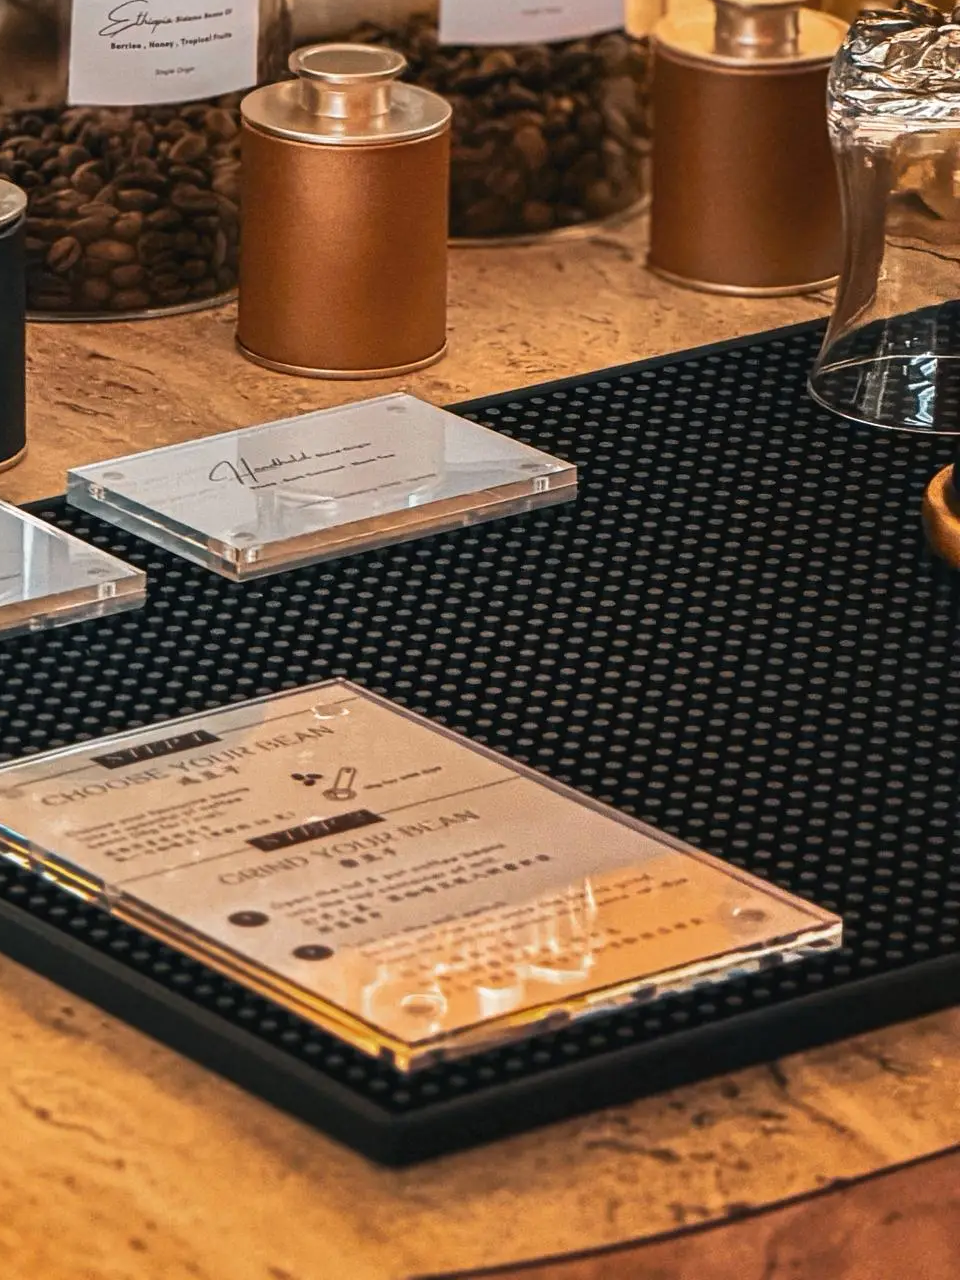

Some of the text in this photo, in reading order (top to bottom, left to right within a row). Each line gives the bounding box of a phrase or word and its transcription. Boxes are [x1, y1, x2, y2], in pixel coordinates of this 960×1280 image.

[98, 0, 172, 38] Ethiopia
[110, 42, 141, 50] Berries
[149, 41, 174, 49] Honey
[180, 33, 212, 45] Tropical
[41, 724, 335, 806] CHOOSE YOUR BEAN
[218, 854, 309, 886] GRIND
[309, 830, 393, 861] YOUR
[397, 809, 481, 840] BEAN
